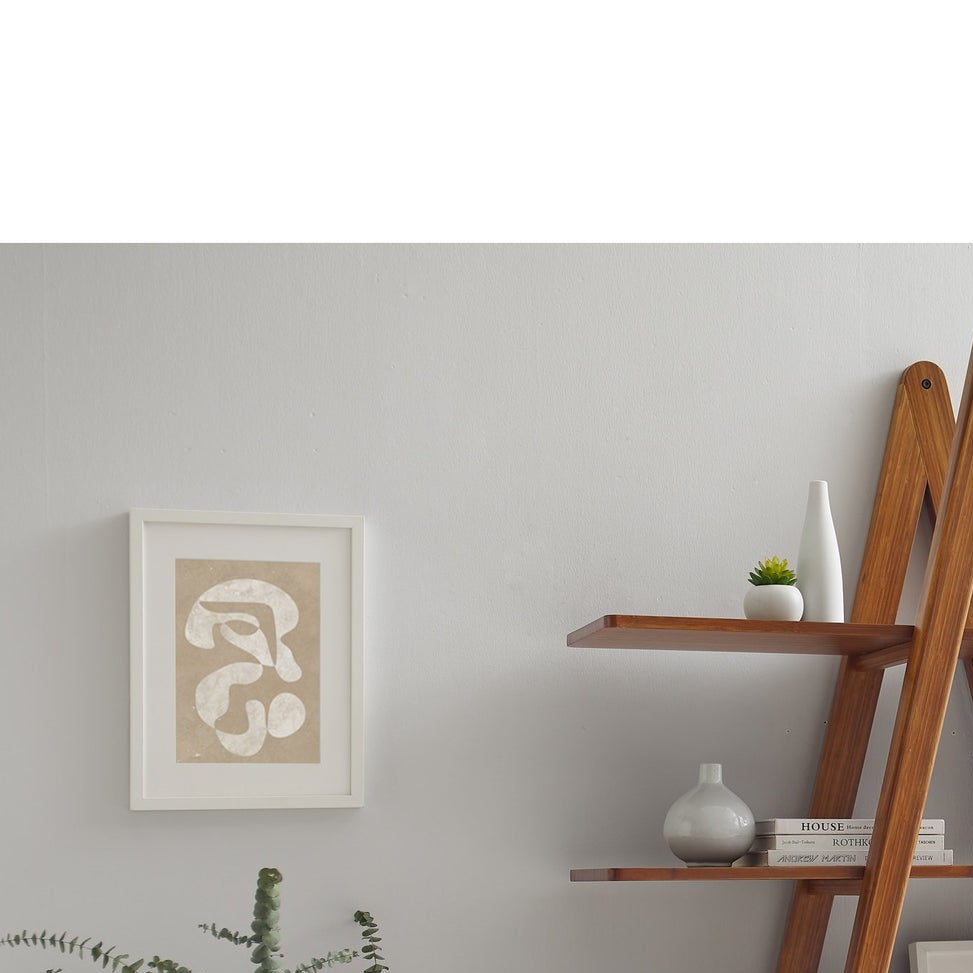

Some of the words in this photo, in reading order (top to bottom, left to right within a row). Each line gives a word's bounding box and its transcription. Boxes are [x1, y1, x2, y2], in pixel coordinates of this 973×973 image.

[801, 822, 845, 831] HOUSE
[777, 854, 819, 863] ANDREW
[821, 854, 857, 863] MARTIN
